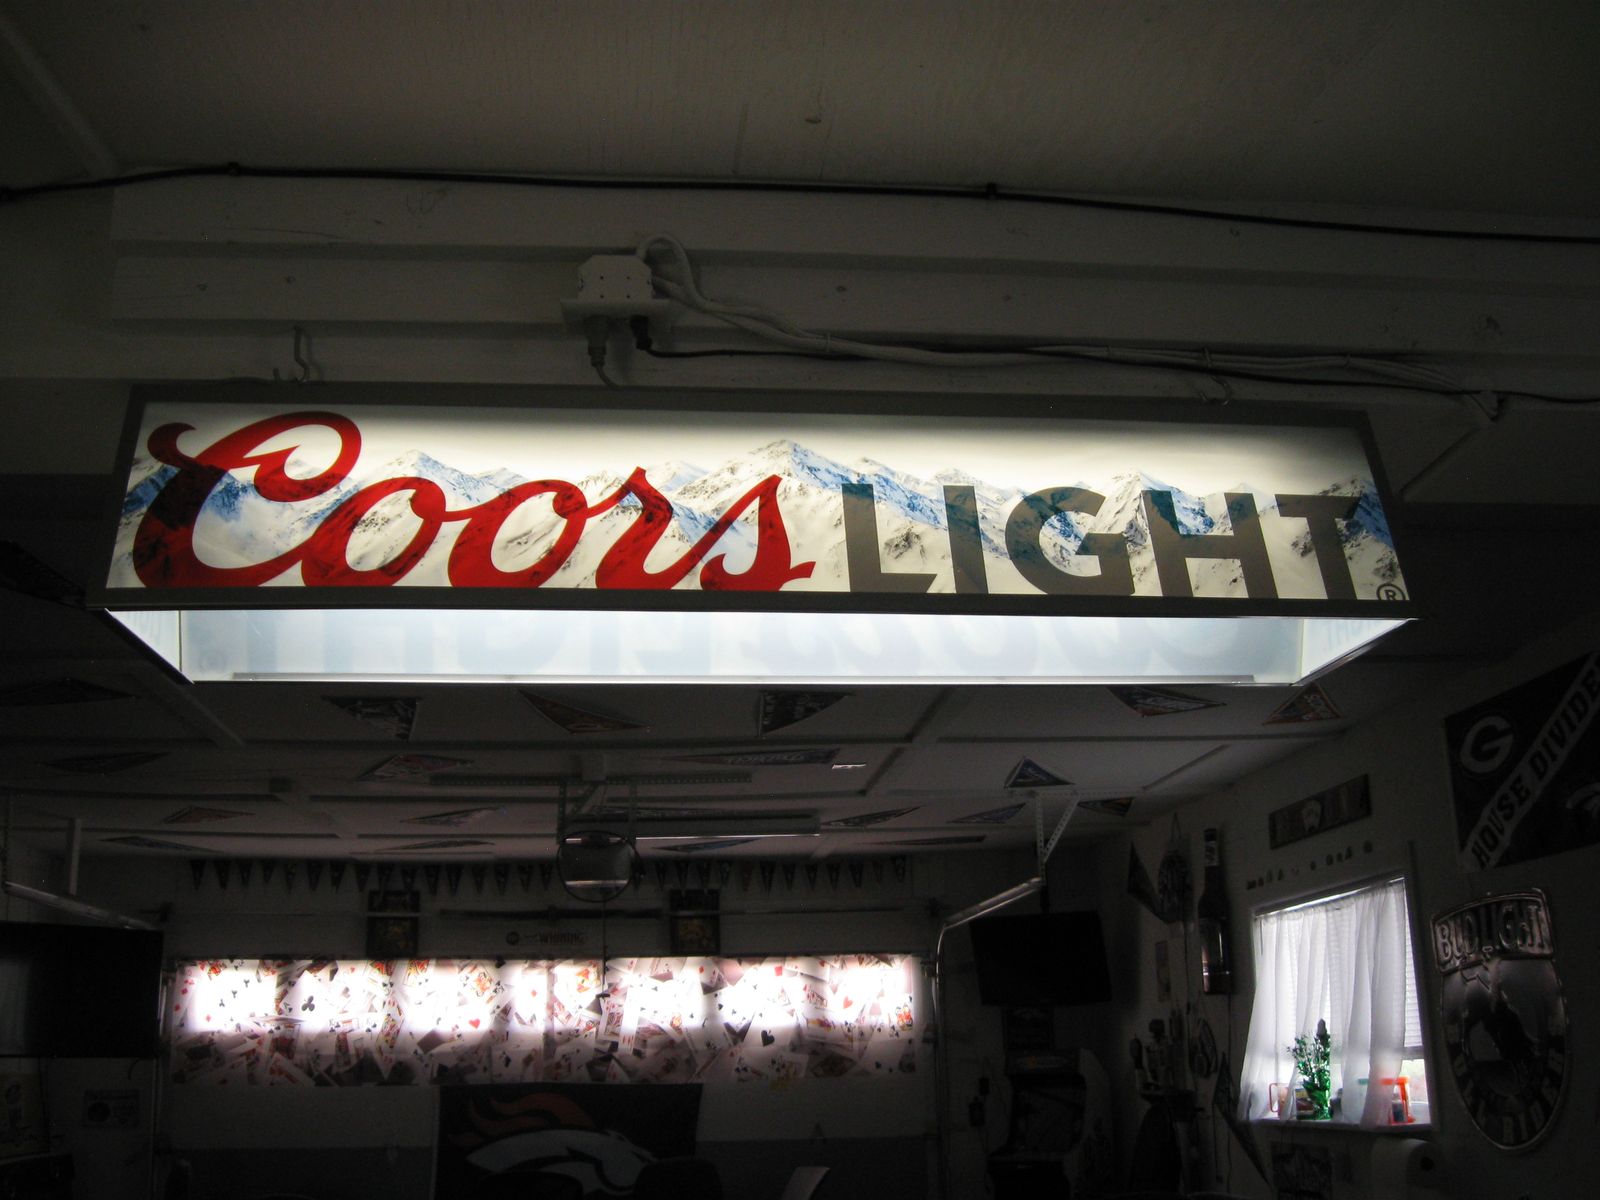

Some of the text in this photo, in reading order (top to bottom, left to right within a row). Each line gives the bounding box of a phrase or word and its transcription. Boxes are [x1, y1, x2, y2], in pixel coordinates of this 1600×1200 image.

[133, 411, 1361, 600] Coors LIGHT
[1460, 715, 1513, 773] G
[1471, 774, 1531, 871] HOUSE
[1437, 902, 1547, 962] BUD LIGHT
